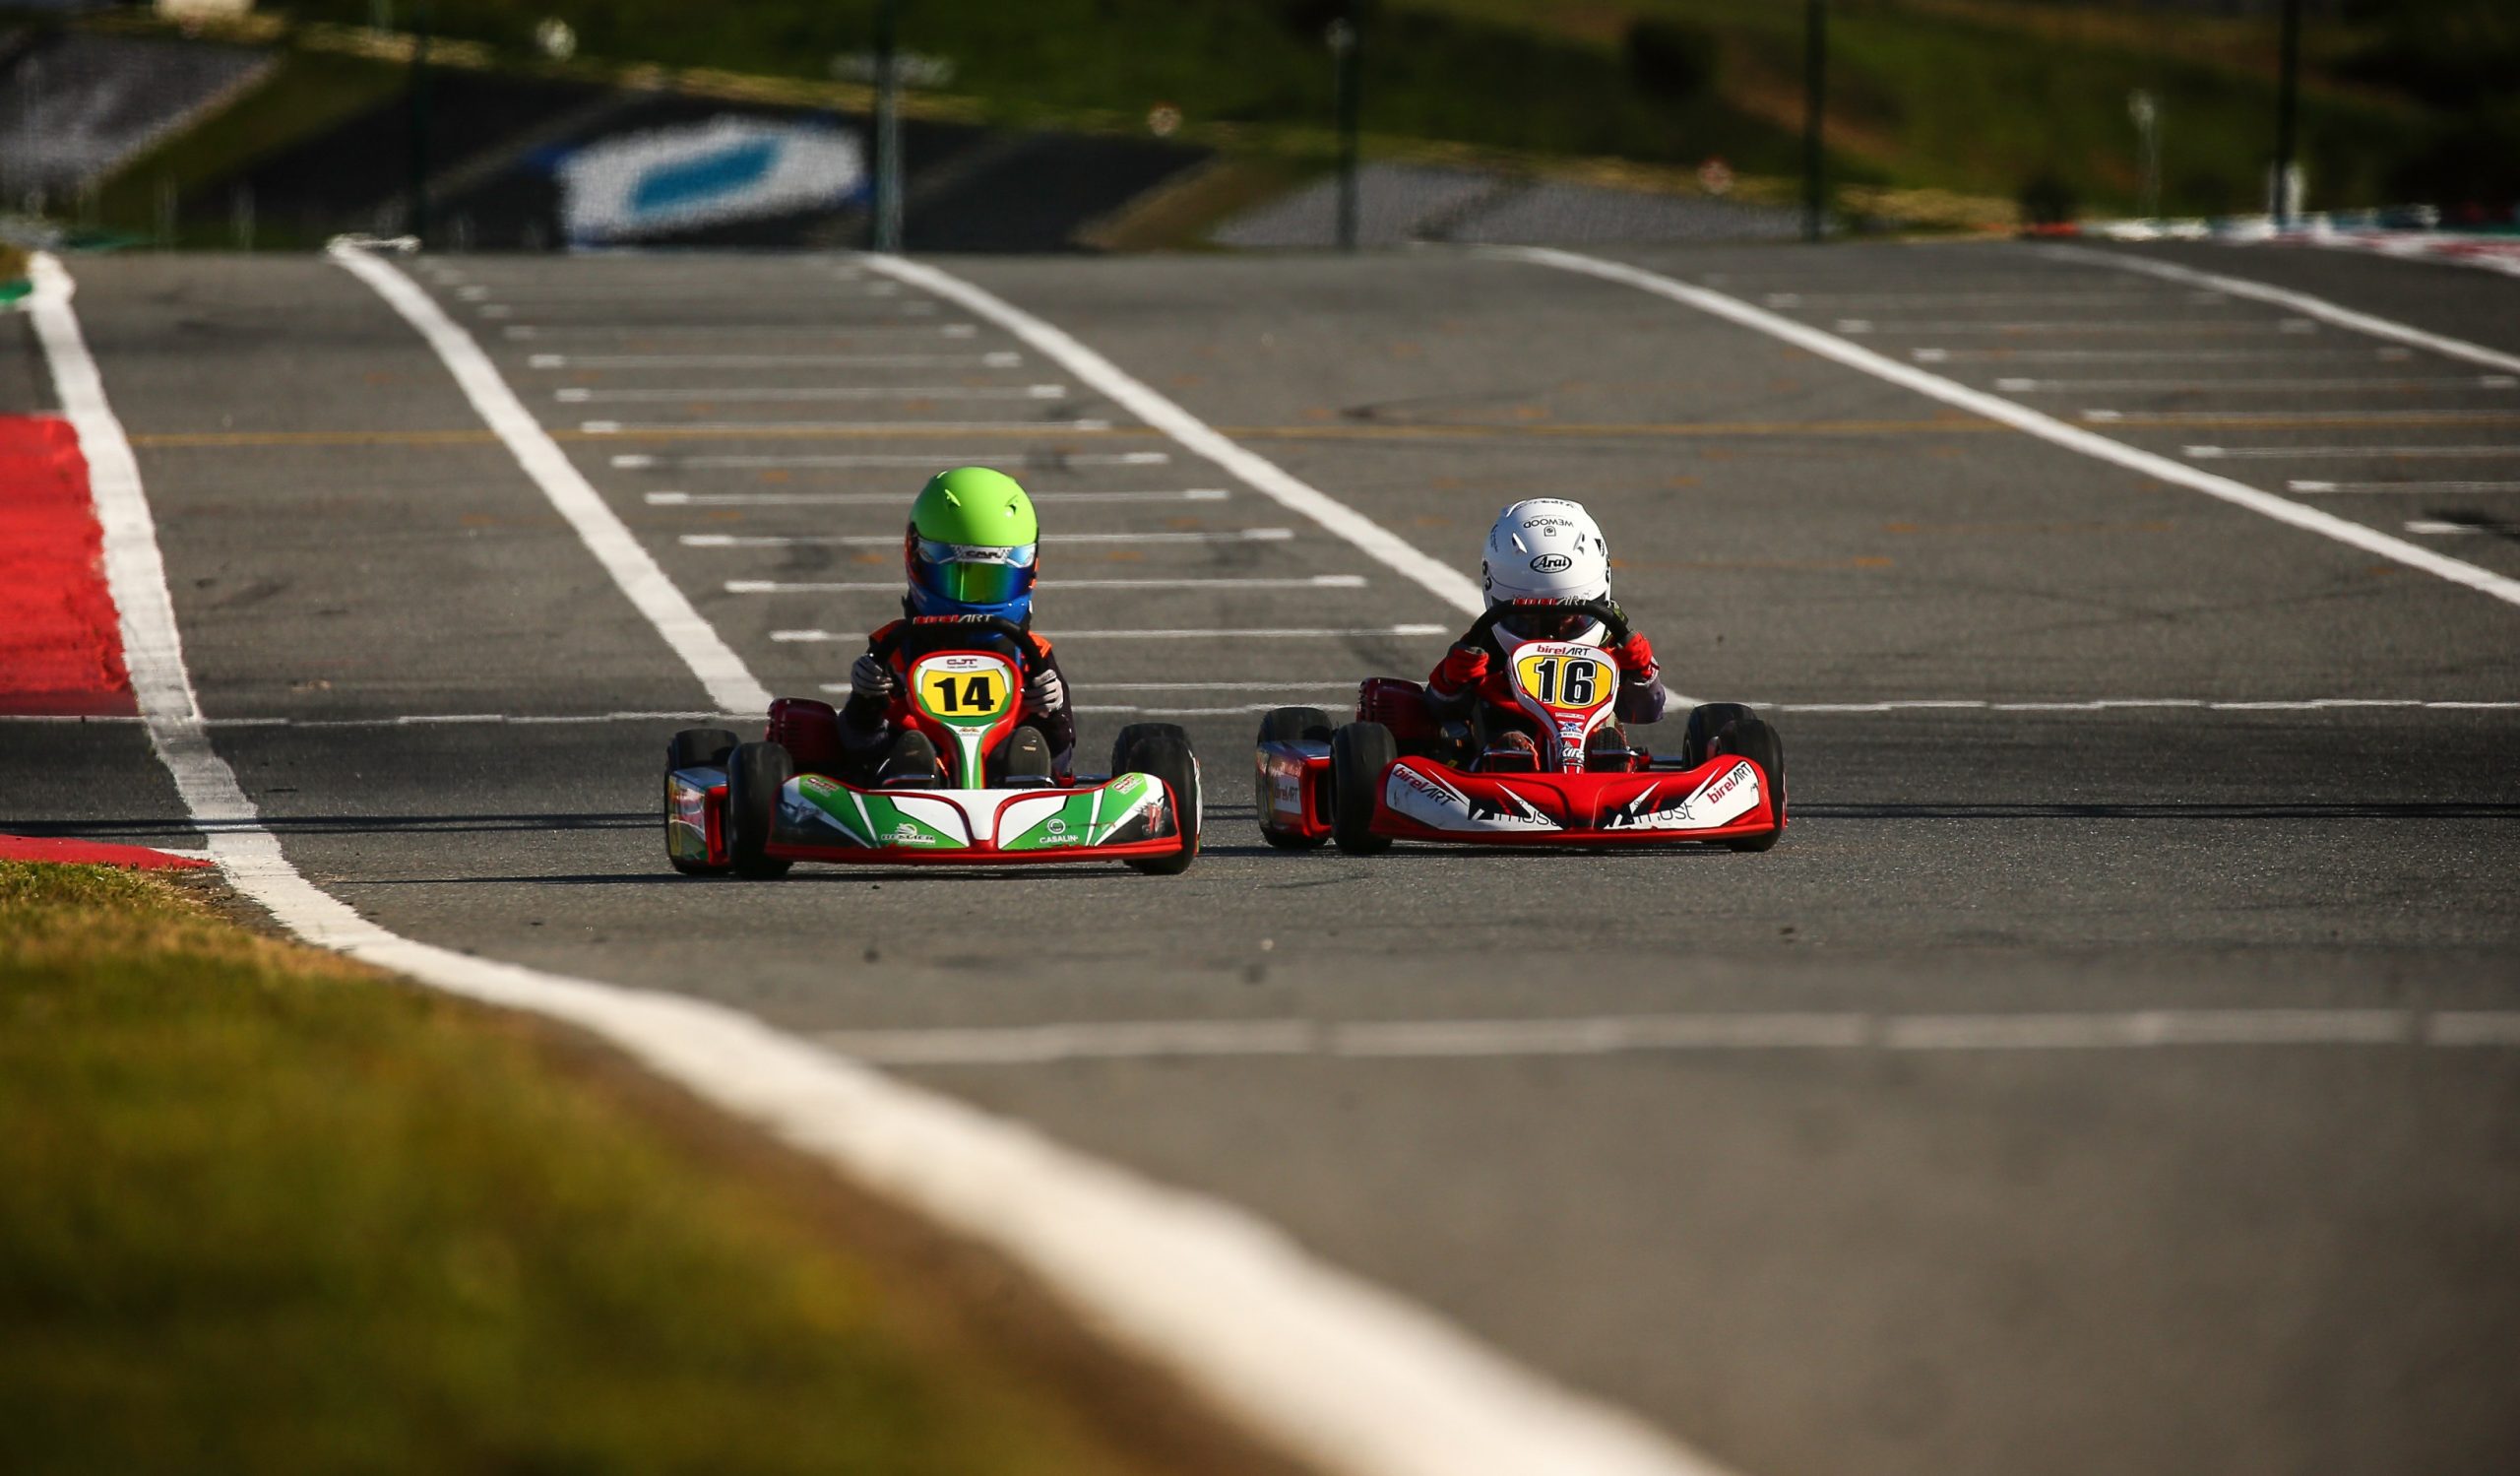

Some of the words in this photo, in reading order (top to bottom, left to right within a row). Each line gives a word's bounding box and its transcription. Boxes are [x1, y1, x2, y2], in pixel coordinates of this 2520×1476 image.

[1523, 518, 1573, 529] WEWOOD
[1539, 556, 1568, 569] Arai
[1537, 644, 1591, 657] birelART
[933, 676, 995, 712] 14
[1534, 657, 1598, 706] 16
[1393, 767, 1457, 806] birelART
[1707, 763, 1751, 804] birelART
